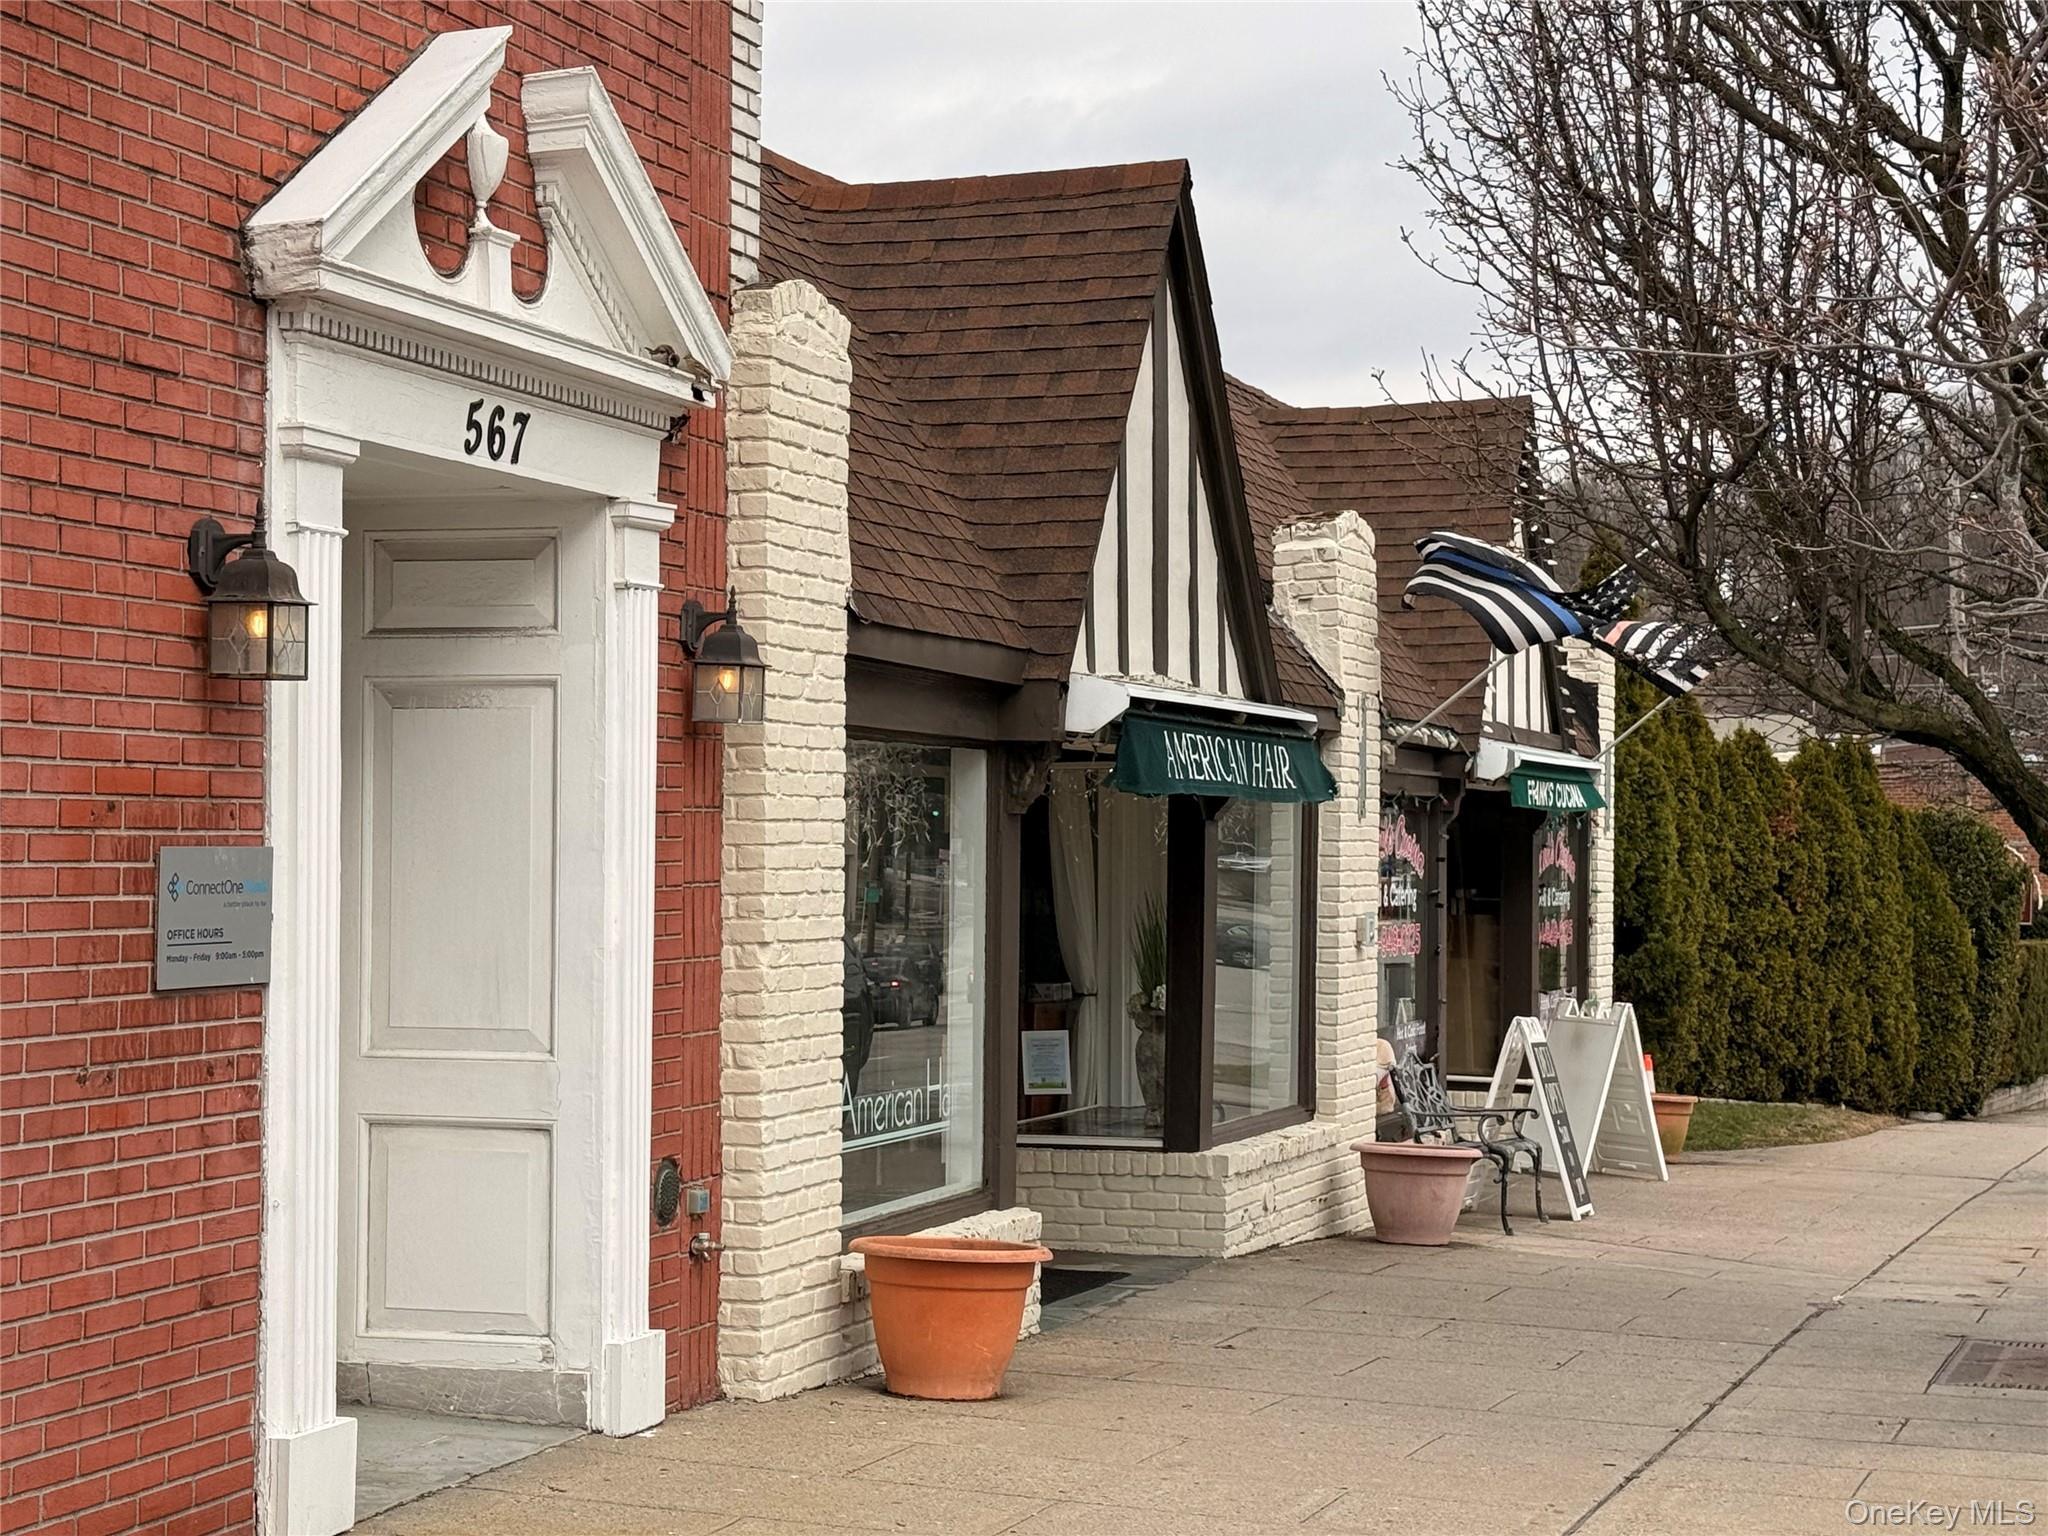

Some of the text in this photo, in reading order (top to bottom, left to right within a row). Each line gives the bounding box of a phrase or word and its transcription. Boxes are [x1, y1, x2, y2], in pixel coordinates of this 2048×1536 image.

[464, 398, 531, 465] 567
[1163, 730, 1296, 789] AMERICAN HAIR
[186, 880, 244, 895] ConnectOne
[167, 927, 224, 940] OFFICE HOURS
[166, 953, 188, 963] Monday
[193, 951, 211, 962] Friday
[215, 950, 238, 961] 9:00am
[842, 1072, 923, 1135] American
